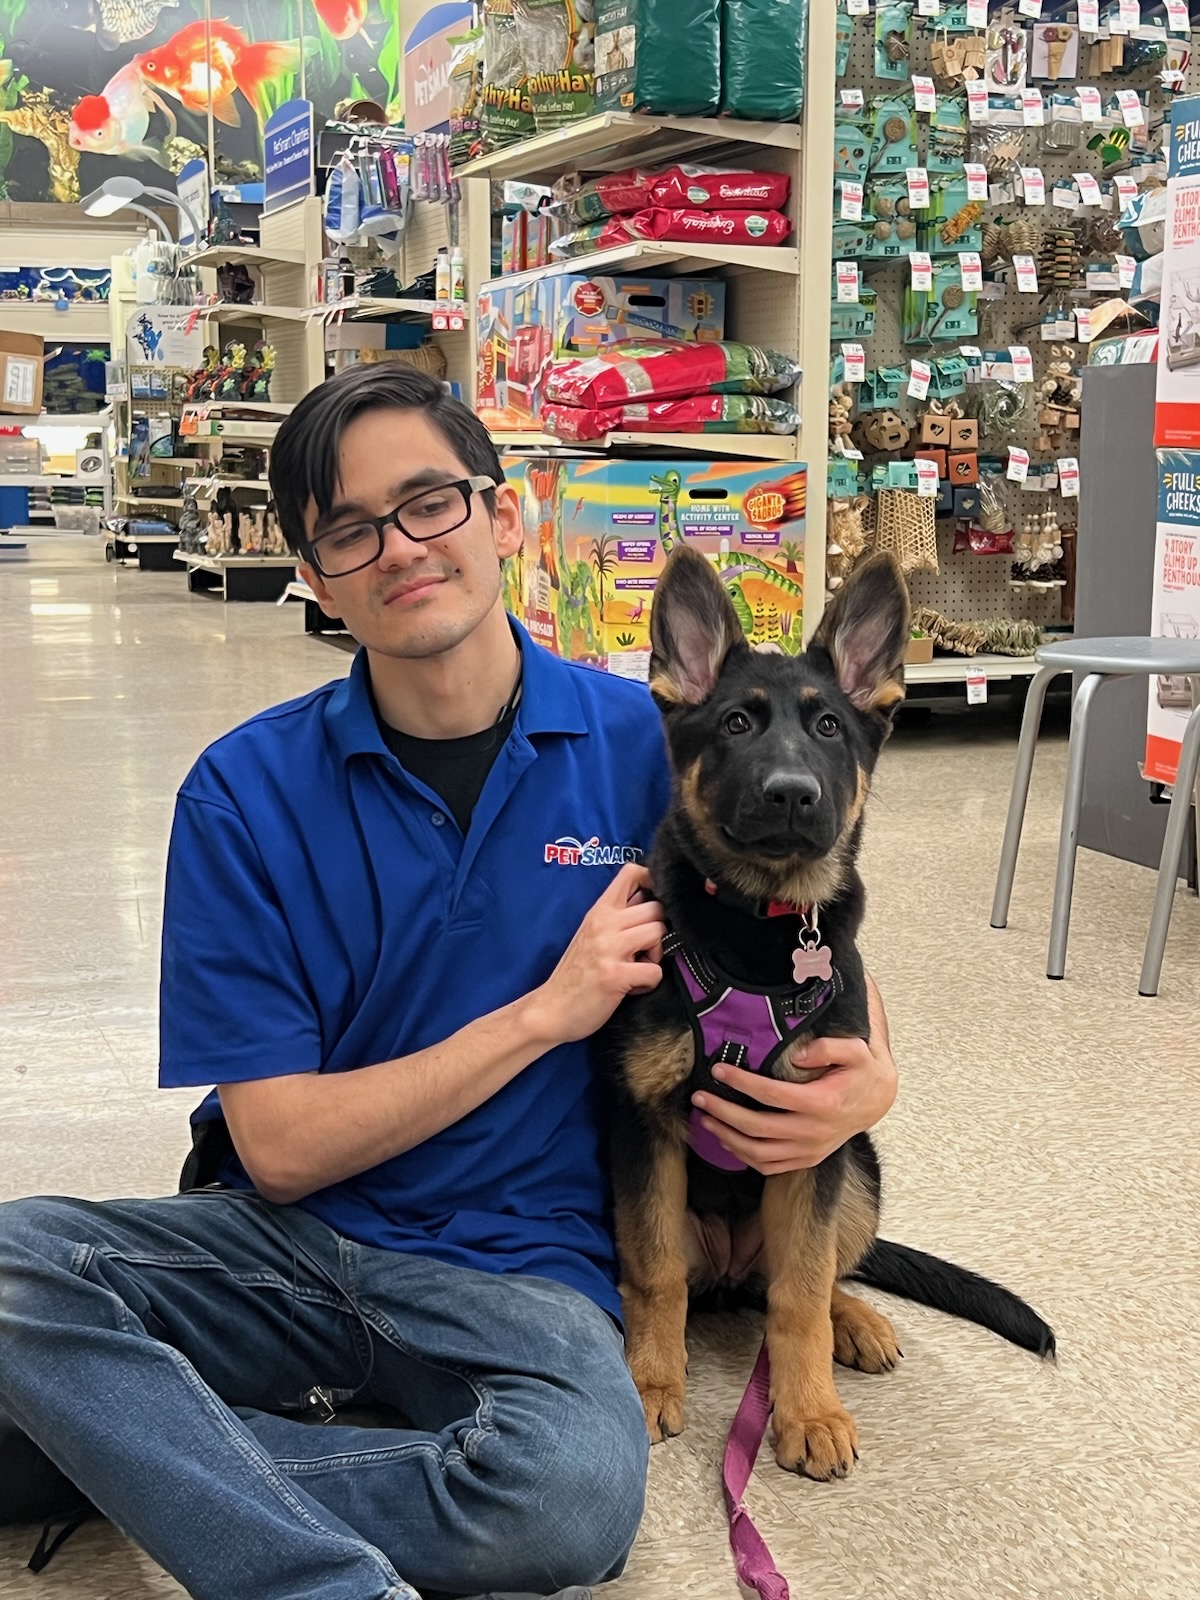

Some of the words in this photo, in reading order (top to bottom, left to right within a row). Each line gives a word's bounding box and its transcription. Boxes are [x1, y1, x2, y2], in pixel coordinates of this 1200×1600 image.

[1185, 120, 1200, 142] FU
[1177, 141, 1200, 163] CHEE
[1181, 190, 1200, 206] STOR
[1172, 472, 1197, 492] FULL
[712, 504, 730, 512] WITH
[748, 493, 782, 510] GIGANTA
[1166, 492, 1200, 514] CHEEKS
[681, 512, 712, 521] ACTIVITY
[713, 513, 740, 521] CENTER
[1170, 538, 1194, 555] STORY
[1187, 555, 1198, 571] UP
[1163, 568, 1200, 587] PENTHOUS
[544, 843, 645, 866] PETSMART
